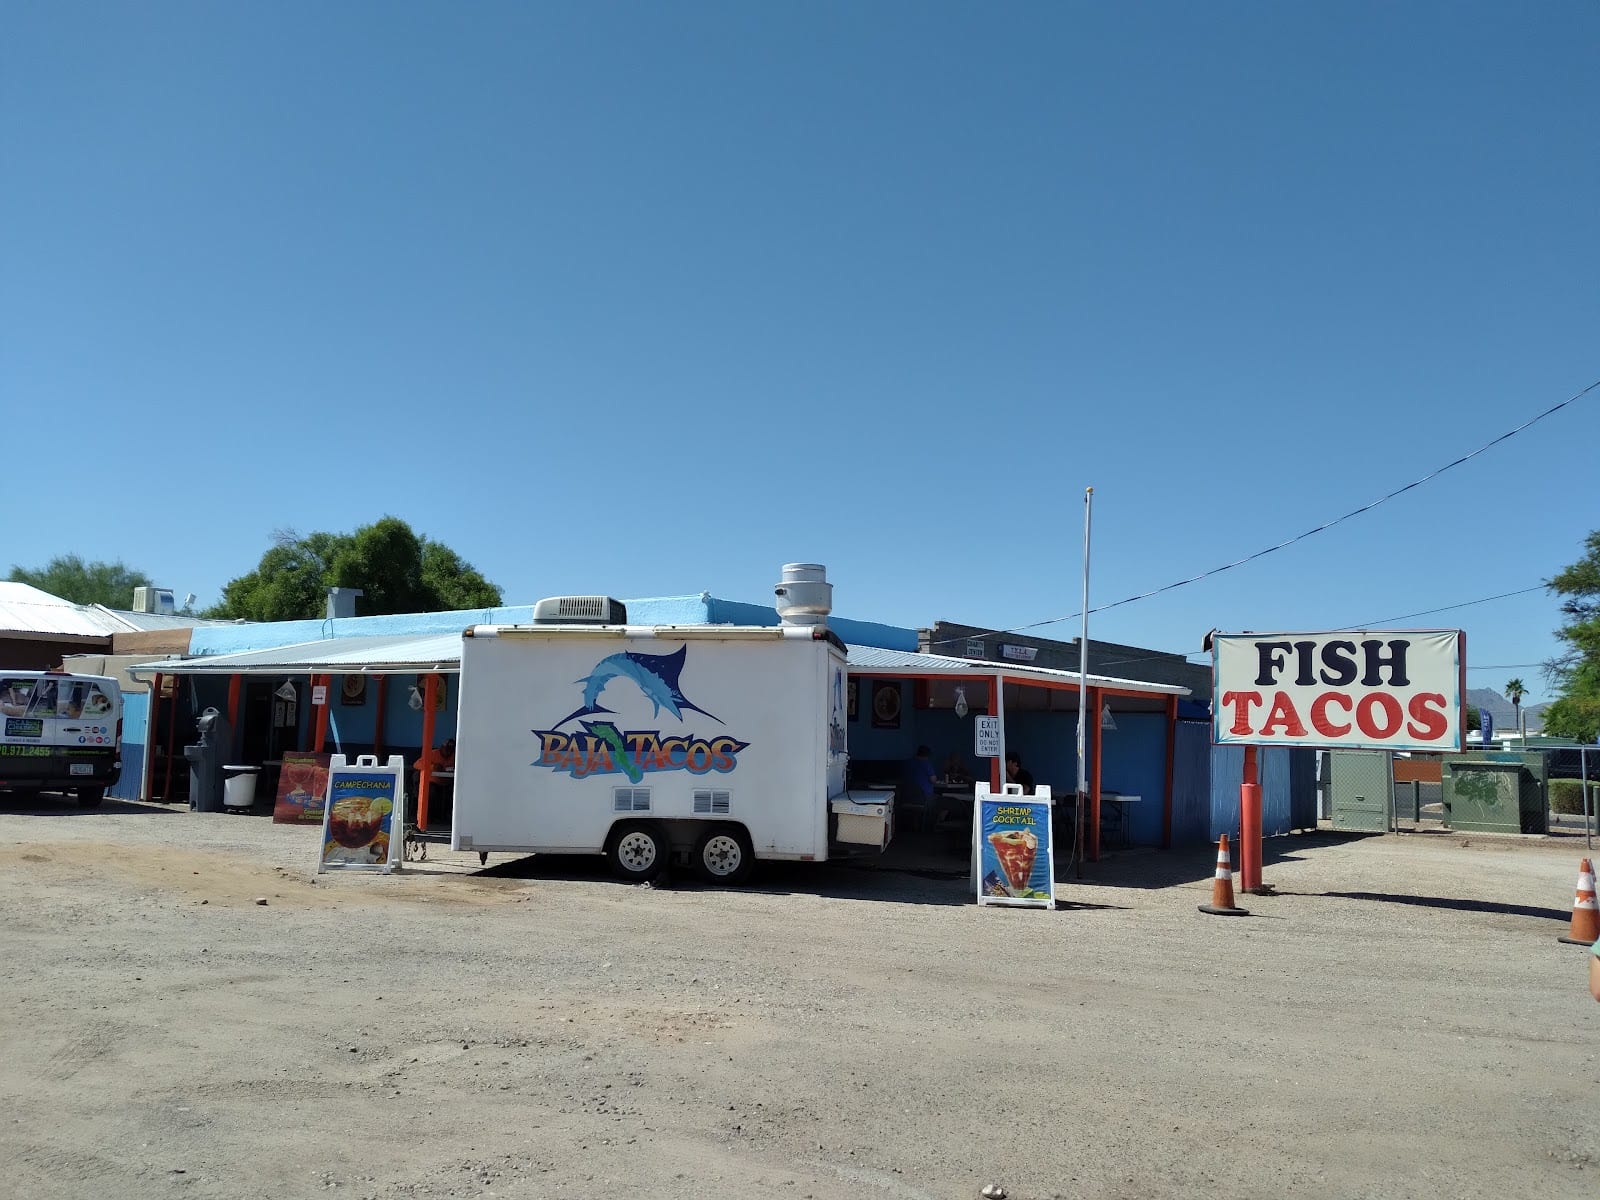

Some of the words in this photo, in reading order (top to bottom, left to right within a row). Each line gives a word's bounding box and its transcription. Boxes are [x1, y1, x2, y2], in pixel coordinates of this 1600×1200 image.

[1254, 639, 1411, 687] FISH
[1222, 690, 1448, 741] TACOS
[981, 720, 998, 729] EXIT
[979, 730, 999, 739] ONLY
[0, 745, 51, 758] 0.971.2455
[543, 733, 614, 776] BAJA
[626, 733, 744, 771] TACOS
[334, 780, 391, 789] CAMPECHANA
[997, 806, 1032, 816] SHRIMP
[992, 815, 1037, 826] COCKTAIL
